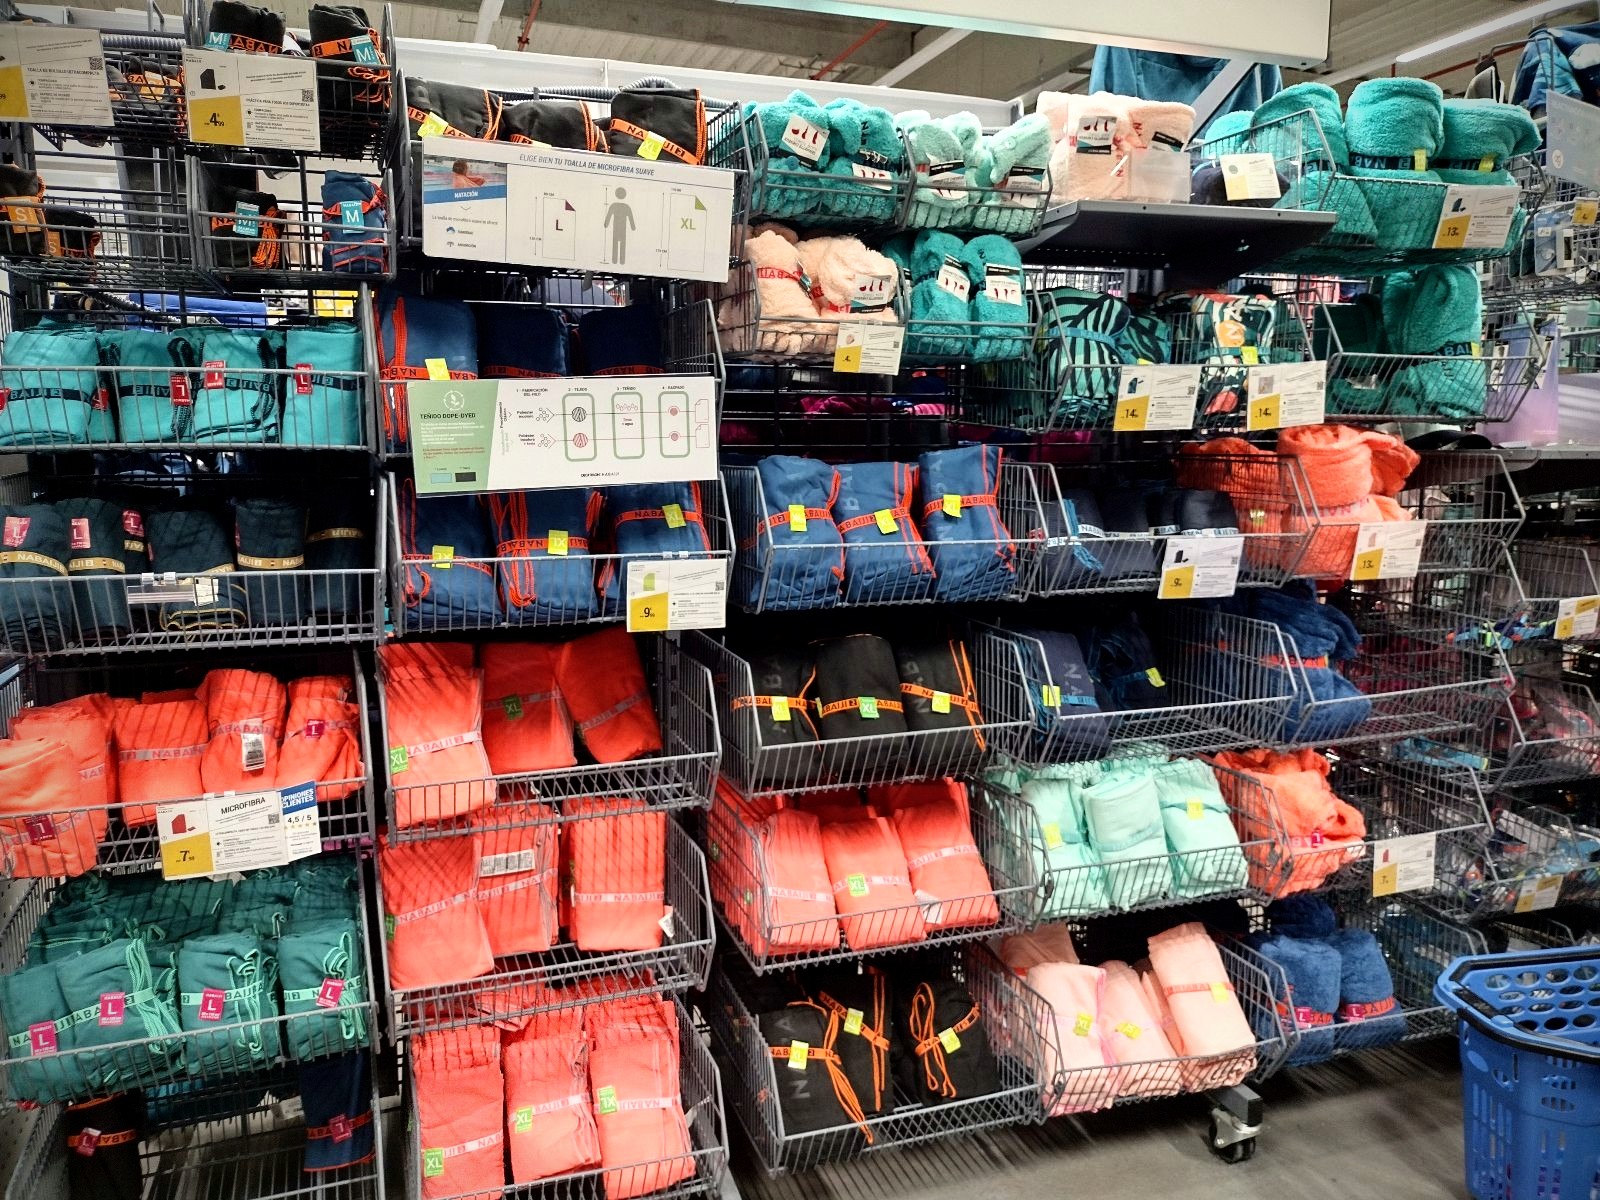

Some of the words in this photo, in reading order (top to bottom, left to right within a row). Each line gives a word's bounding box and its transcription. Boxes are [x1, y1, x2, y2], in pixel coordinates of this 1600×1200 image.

[209, 32, 223, 45] M
[356, 49, 371, 63] M
[564, 158, 587, 169] TOALLA
[598, 163, 634, 174] MICROFIBRA
[635, 168, 654, 176] SUAVE
[15, 207, 28, 222] S
[346, 210, 360, 223] M
[556, 219, 563, 231] L
[680, 218, 696, 230] XL
[176, 384, 186, 397] L
[74, 528, 83, 540] L
[506, 702, 521, 713] XL
[862, 703, 876, 713] XL
[390, 753, 406, 766] XL
[281, 788, 314, 801] OPINIONES
[220, 796, 266, 815] MICROFIBRA
[282, 796, 314, 808] CLIENTES
[288, 816, 300, 824] 4,5
[849, 880, 866, 890] XL
[326, 988, 334, 1000] L
[107, 1002, 117, 1015] L
[208, 1000, 216, 1011] L
[1352, 1008, 1360, 1016] L
[38, 1034, 49, 1046] L
[600, 1096, 616, 1107] XL
[517, 1113, 531, 1124] XL
[426, 1158, 441, 1169] XL
